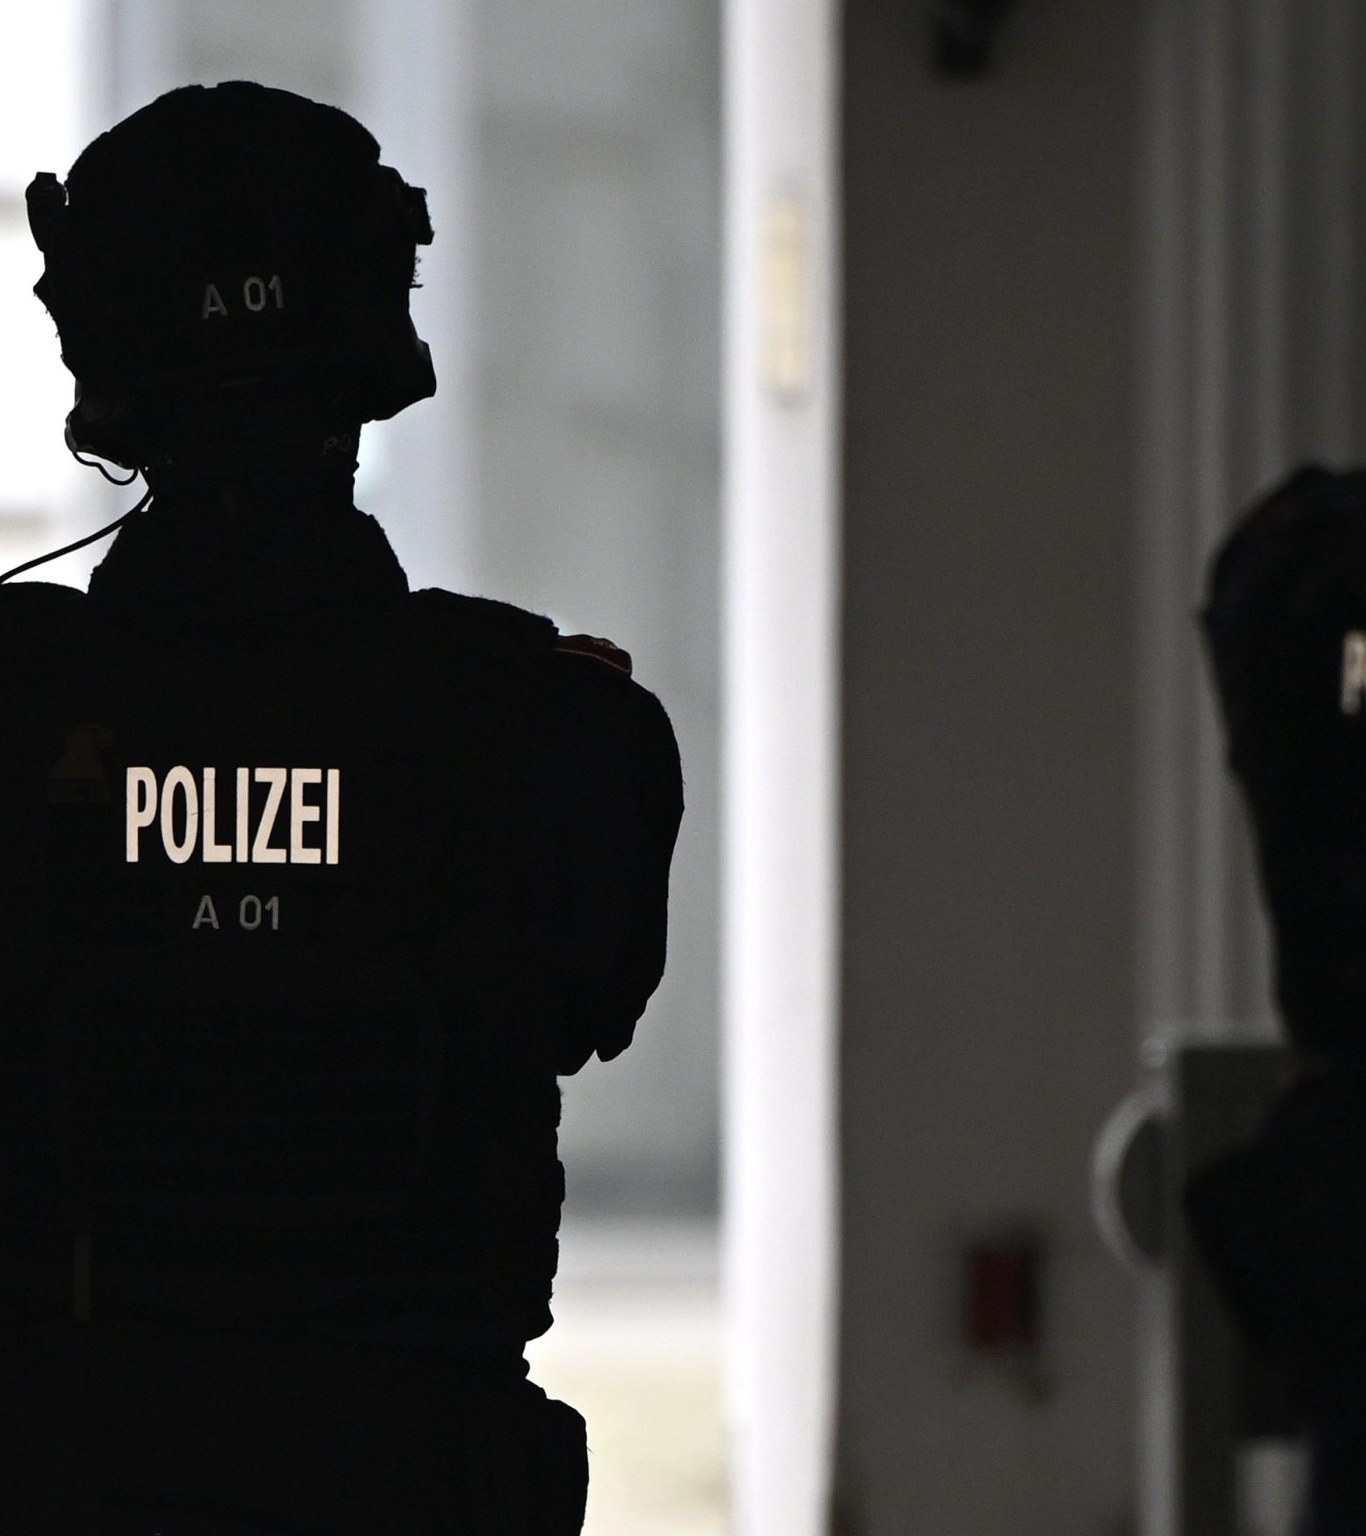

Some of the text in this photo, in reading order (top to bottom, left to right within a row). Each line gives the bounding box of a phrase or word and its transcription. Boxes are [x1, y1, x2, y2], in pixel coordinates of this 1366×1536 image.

[201, 274, 284, 320] A 01
[125, 764, 341, 865] POLIZEI
[191, 894, 280, 931] A 01
